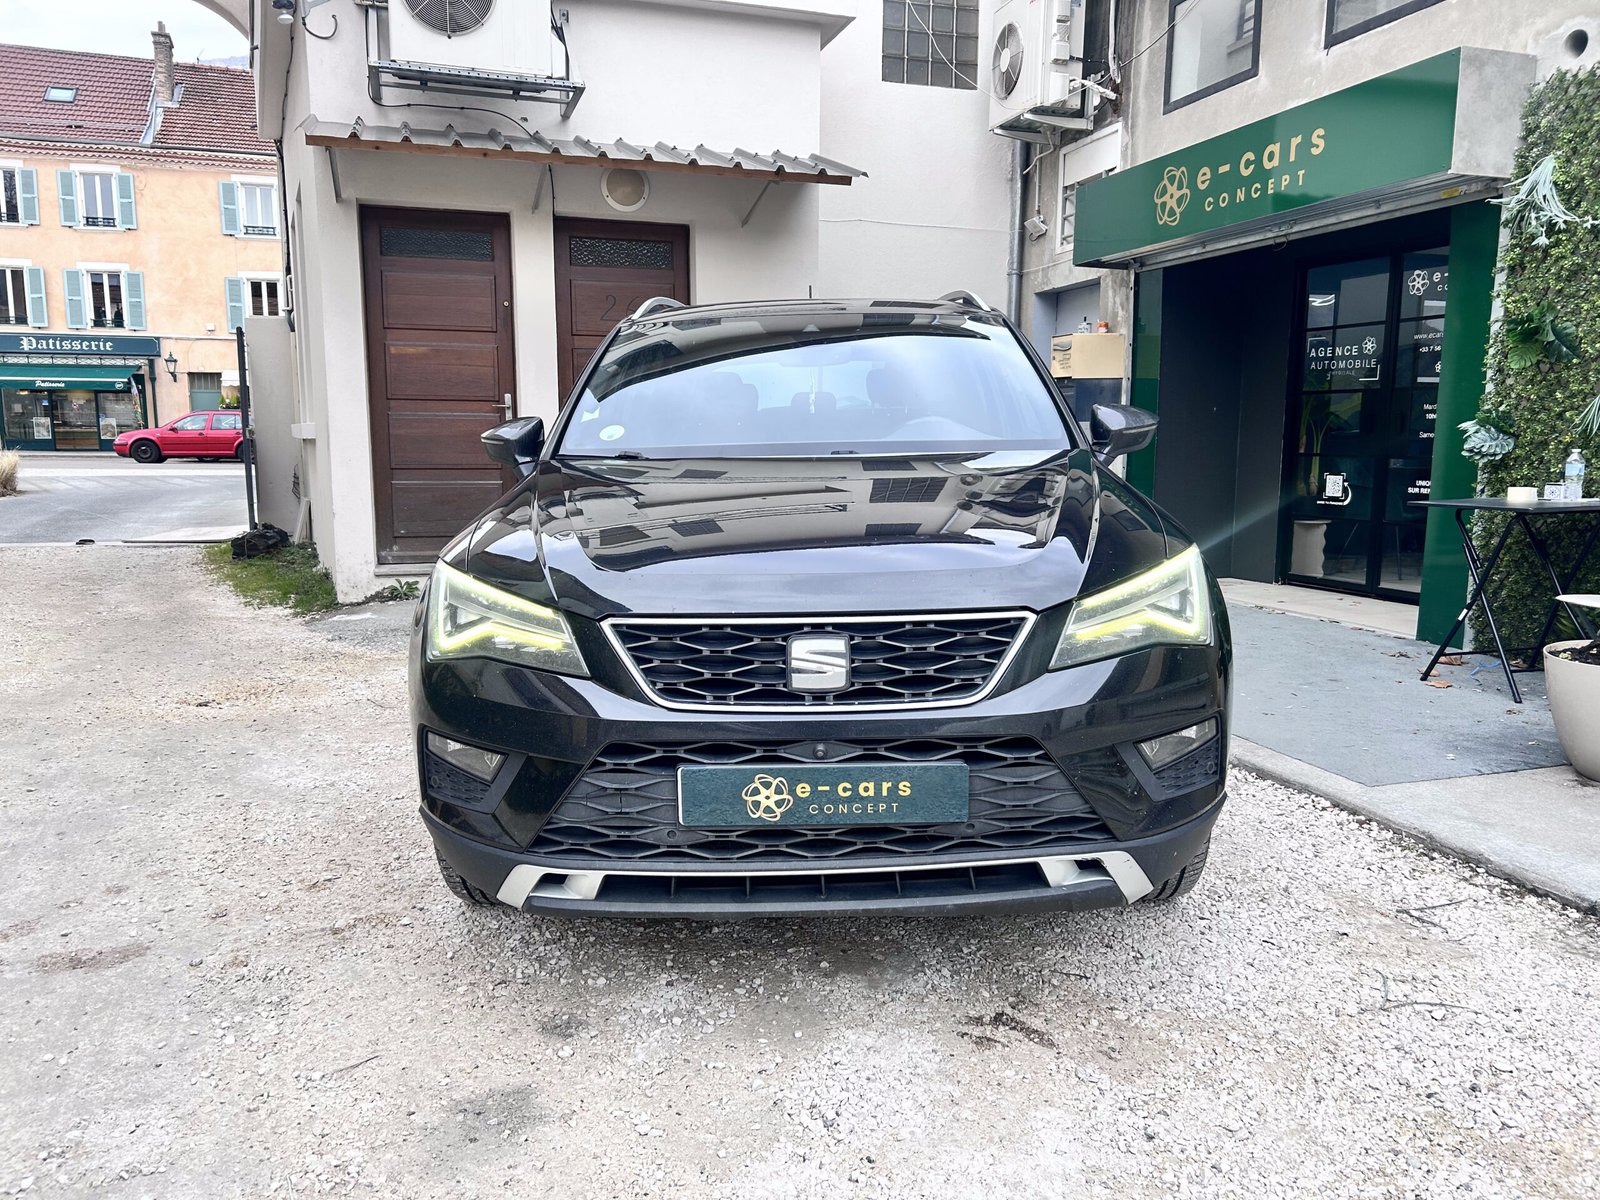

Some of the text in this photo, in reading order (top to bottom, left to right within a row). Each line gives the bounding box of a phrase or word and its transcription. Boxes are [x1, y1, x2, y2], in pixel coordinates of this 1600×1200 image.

[1196, 127, 1326, 190] e-cars
[1204, 169, 1305, 211] CONCEPT
[19, 336, 114, 351] Patisserie
[1309, 345, 1359, 357] AGENCE
[1310, 358, 1377, 370] AUTOMOBILE
[34, 380, 65, 388] Patisserie
[795, 778, 912, 798] e-cars
[809, 803, 899, 815] CONCEPT
